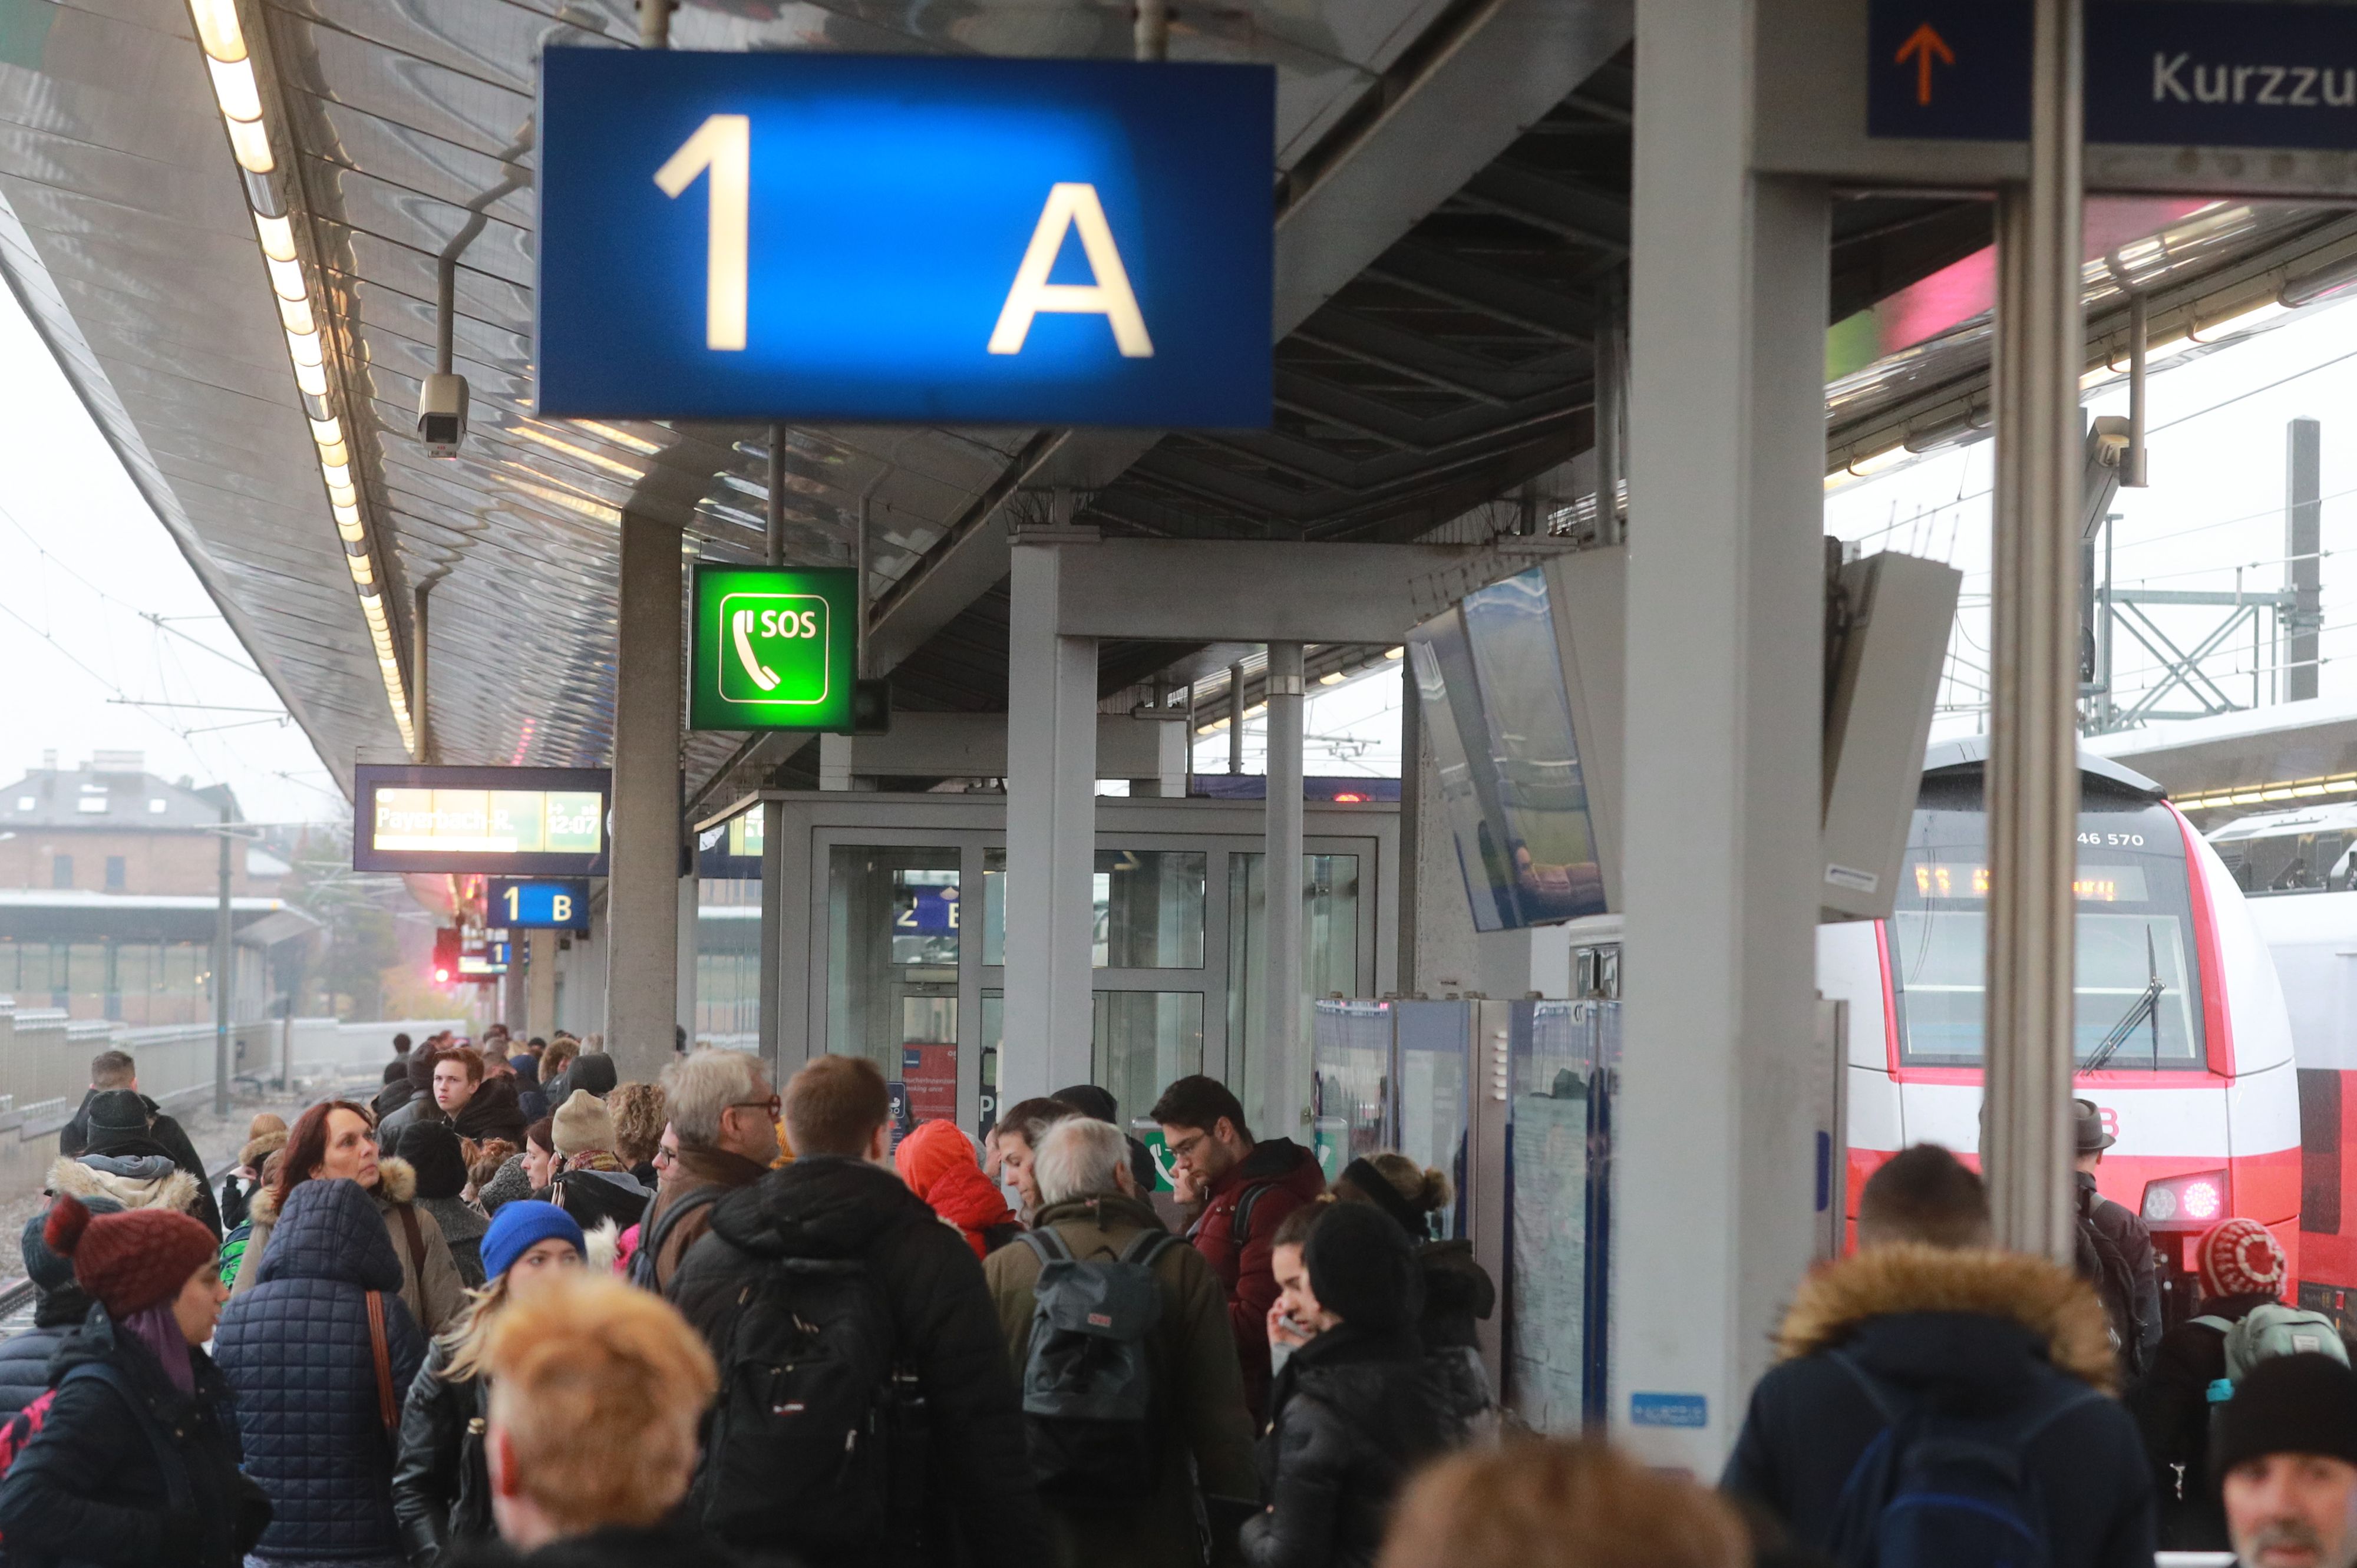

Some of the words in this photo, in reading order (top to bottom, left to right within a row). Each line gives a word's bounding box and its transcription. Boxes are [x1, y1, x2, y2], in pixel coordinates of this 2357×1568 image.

[2153, 51, 2356, 106] Kurzzu
[653, 114, 750, 351] 1
[987, 183, 1154, 357] A
[761, 610, 816, 638] SOS
[547, 816, 597, 834] 12:07
[2077, 832, 2101, 844] 46
[2108, 833, 2144, 846] 570
[503, 886, 519, 921] 1
[552, 894, 572, 922] B
[897, 896, 918, 927] 2
[493, 943, 503, 963] 1
[980, 1095, 995, 1123] P
